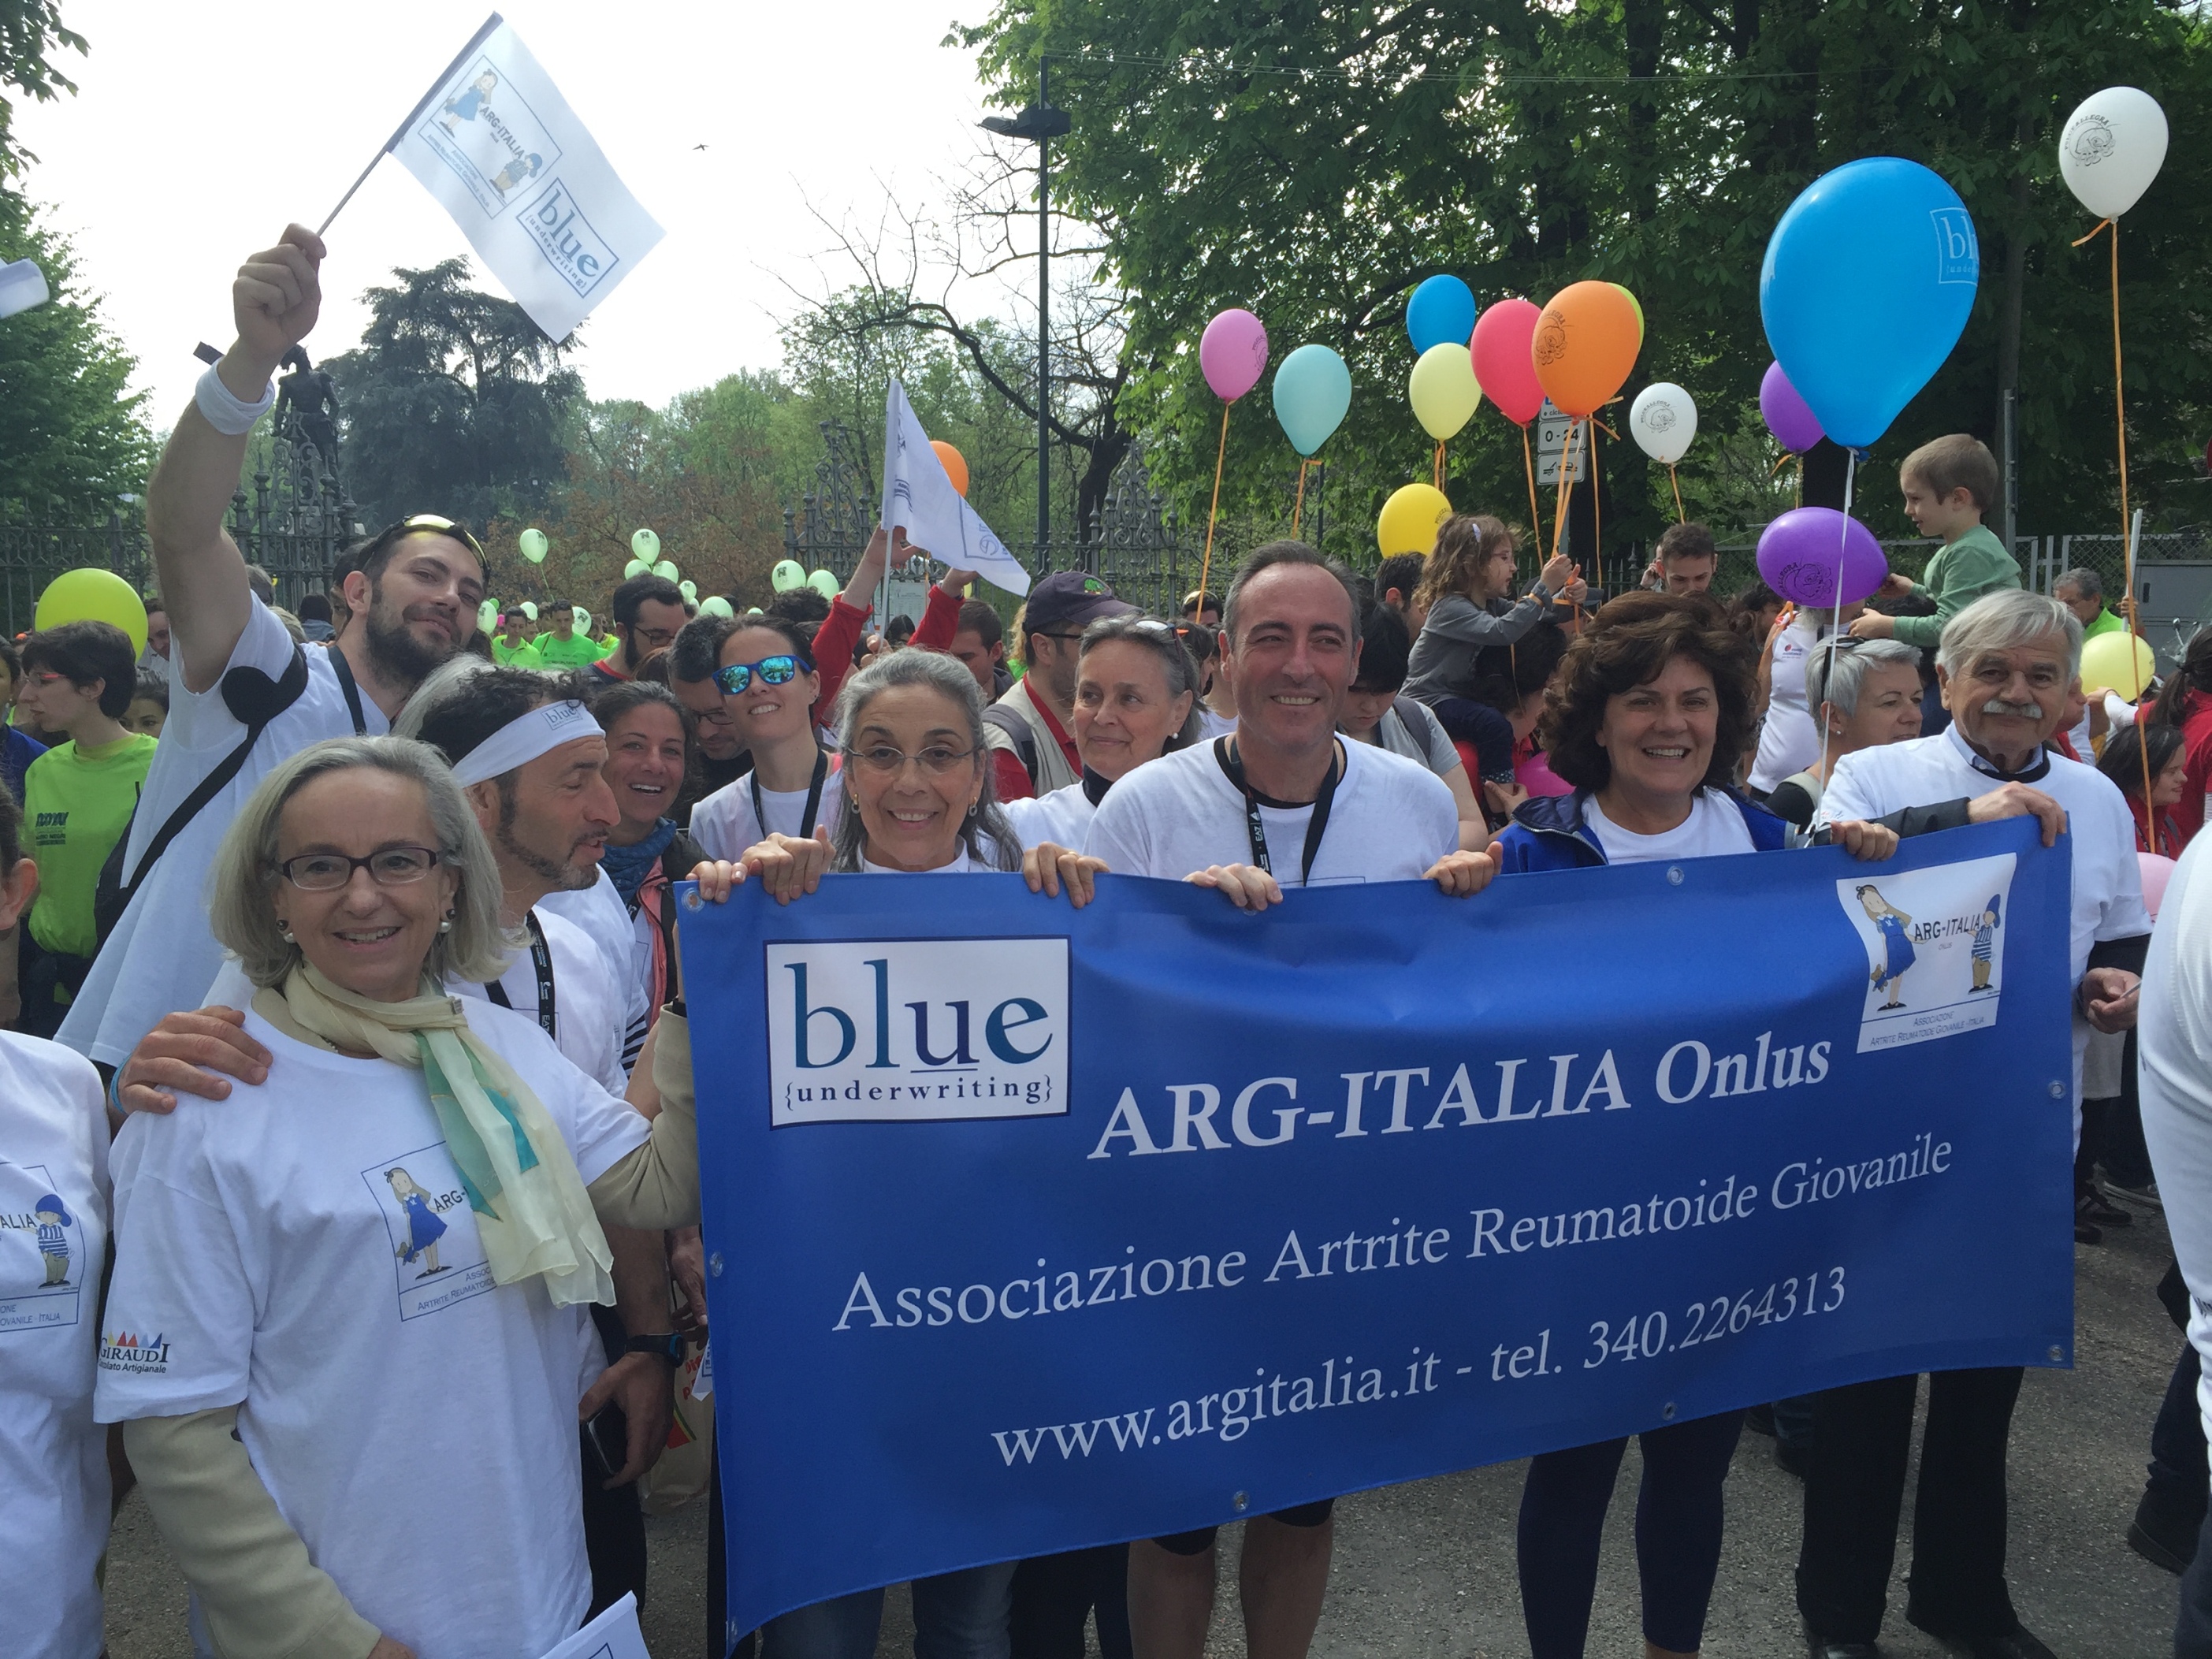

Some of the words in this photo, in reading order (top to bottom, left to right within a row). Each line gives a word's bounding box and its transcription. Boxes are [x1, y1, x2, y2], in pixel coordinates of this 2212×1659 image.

[479, 106, 526, 159] ARG-ITALIA
[537, 188, 600, 277] blue
[1545, 430, 1553, 442] 0
[1563, 428, 1579, 441] 24
[545, 707, 577, 723] blue
[1914, 913, 1980, 941] ARG-ITALIA
[783, 958, 1053, 1070] blue
[1913, 1010, 1955, 1027] ASSOCIAZIONE
[1870, 1034, 1896, 1047] ARTRITE
[1897, 1027, 1935, 1043] REUMATOIDE
[1935, 1021, 1965, 1034] GIOVANILE
[784, 1074, 1053, 1111] {underwriting}
[1086, 1048, 1632, 1159] ARG-ITALIA
[1655, 1030, 1831, 1104] Onlus
[0, 1214, 38, 1229] ALIA
[831, 1245, 1247, 1331] Associazione
[1262, 1217, 1450, 1282] Artrite
[1466, 1174, 1758, 1259] Reumatoide
[1771, 1132, 1952, 1210] Giovanile
[466, 1266, 492, 1281] ASSOC
[0, 1304, 17, 1314] ONE
[418, 1293, 449, 1311] ARTRITE
[0, 1315, 33, 1326] OVANILE
[39, 1312, 61, 1322] ITALIA
[100, 1337, 171, 1363] GIRAUDI
[121, 1363, 166, 1374] Artigianale
[991, 1346, 1441, 1467] www.argitalia.it
[1490, 1329, 1563, 1382] tel.
[1582, 1266, 1846, 1369] 340.2264313
